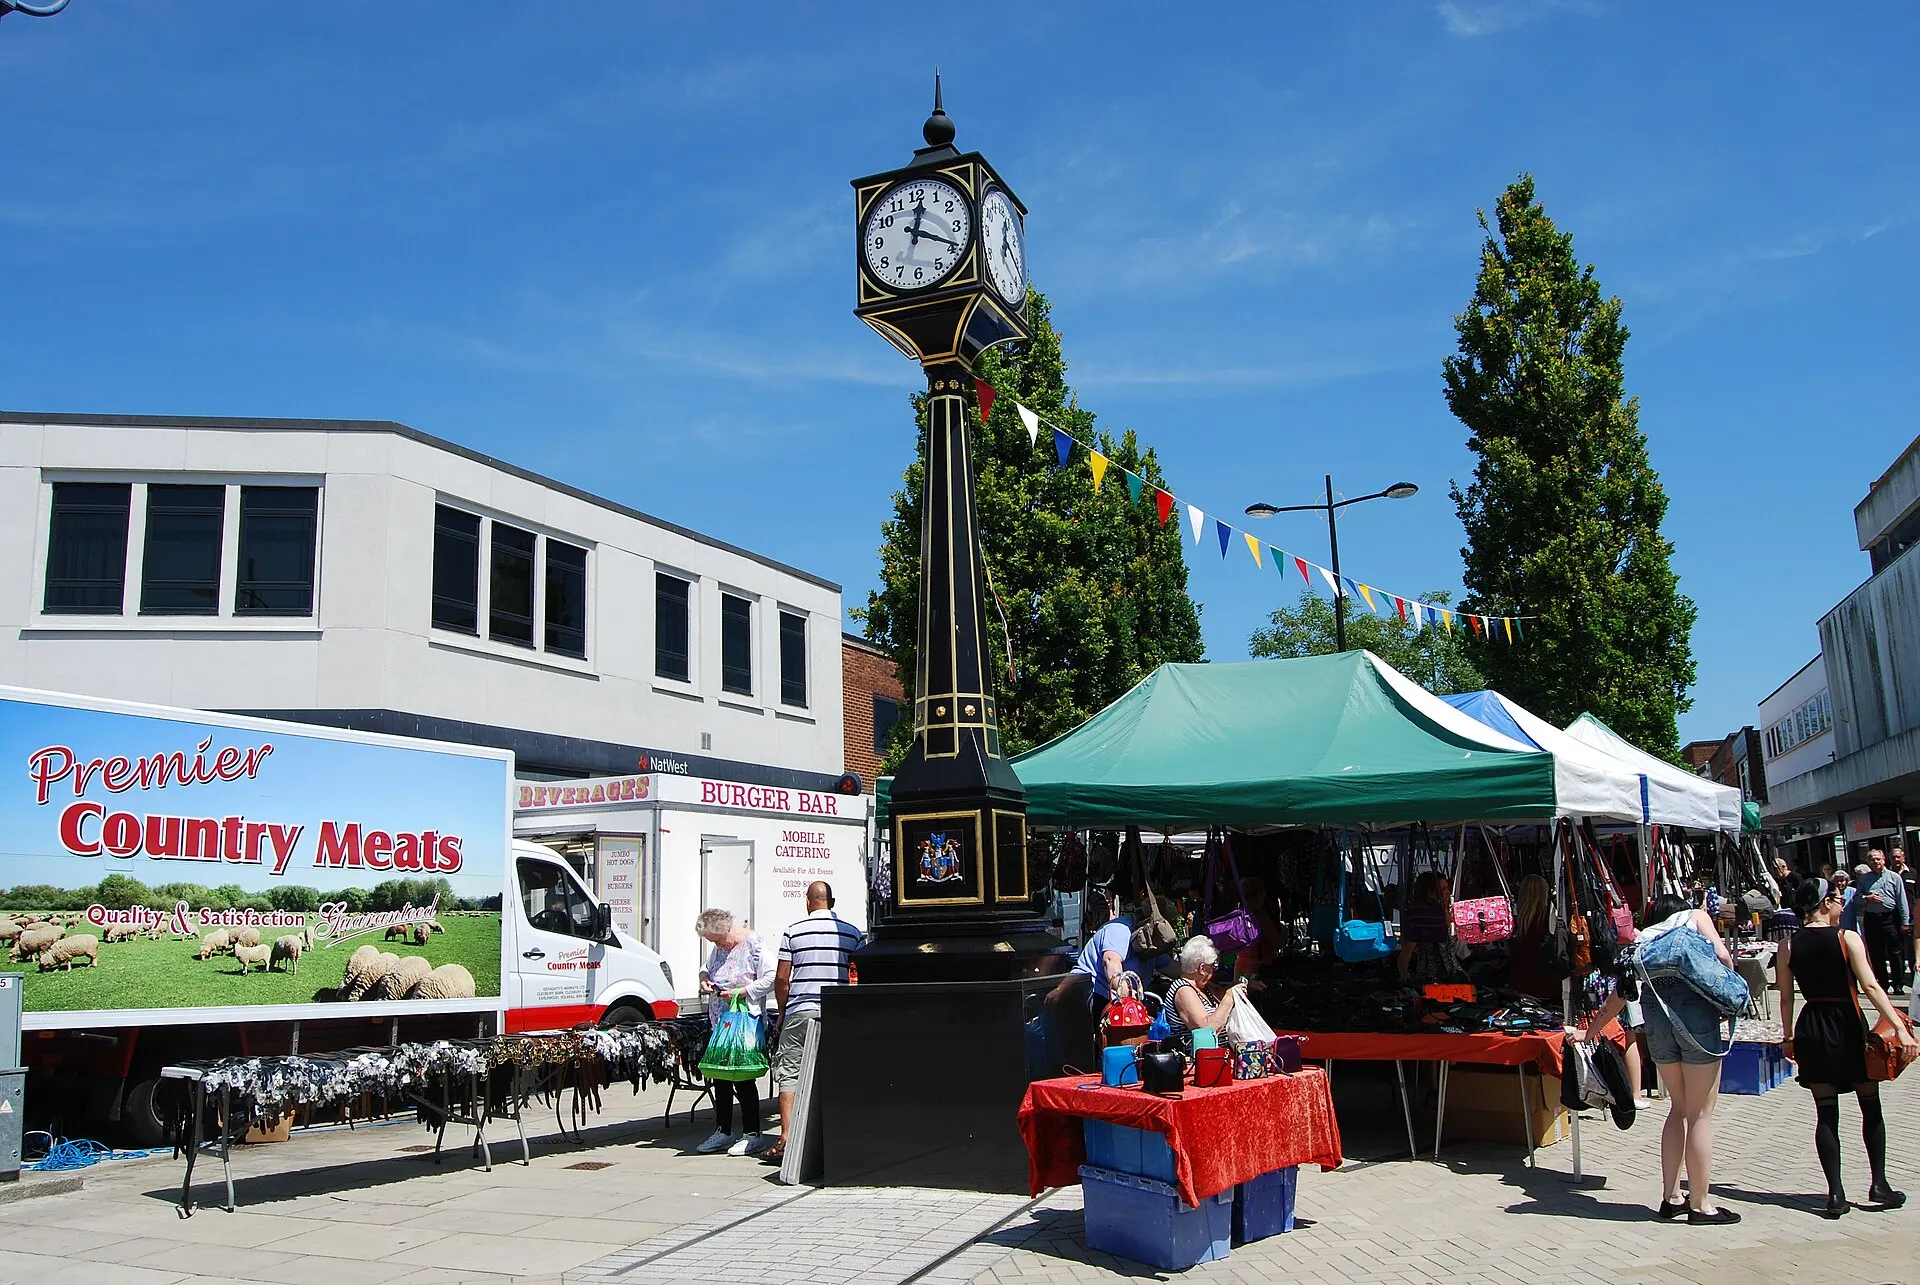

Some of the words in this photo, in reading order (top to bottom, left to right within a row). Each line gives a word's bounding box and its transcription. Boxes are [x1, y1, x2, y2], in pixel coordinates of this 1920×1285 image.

[908, 189, 925, 203] 12
[933, 190, 940, 203] 1
[890, 199, 904, 213] 11
[945, 200, 954, 213] 2
[879, 215, 894, 229] 10
[952, 220, 961, 232] 3
[875, 237, 884, 249] 9
[947, 243, 956, 254] 4
[880, 256, 889, 269] 8
[934, 257, 943, 270] 5
[896, 265, 905, 278] 7
[914, 267, 923, 280] 6
[29, 735, 273, 805] Premier
[650, 756, 688, 775] NatWest
[519, 776, 650, 808] BEVERAGES
[701, 781, 790, 811] BURGER
[798, 792, 838, 815] BAR
[58, 801, 304, 875] Country
[313, 819, 463, 874] Meats
[782, 830, 825, 844] MOBILE
[775, 845, 830, 859] CATERING
[772, 866, 795, 874] Available
[783, 880, 801, 888] 01329
[87, 903, 167, 931] Quality
[170, 900, 193, 935] &
[199, 907, 306, 928] Satisfaction
[313, 892, 440, 940] Guaranteed
[558, 948, 587, 960] Premier
[547, 961, 577, 971] Country
[579, 961, 601, 970] Meats
